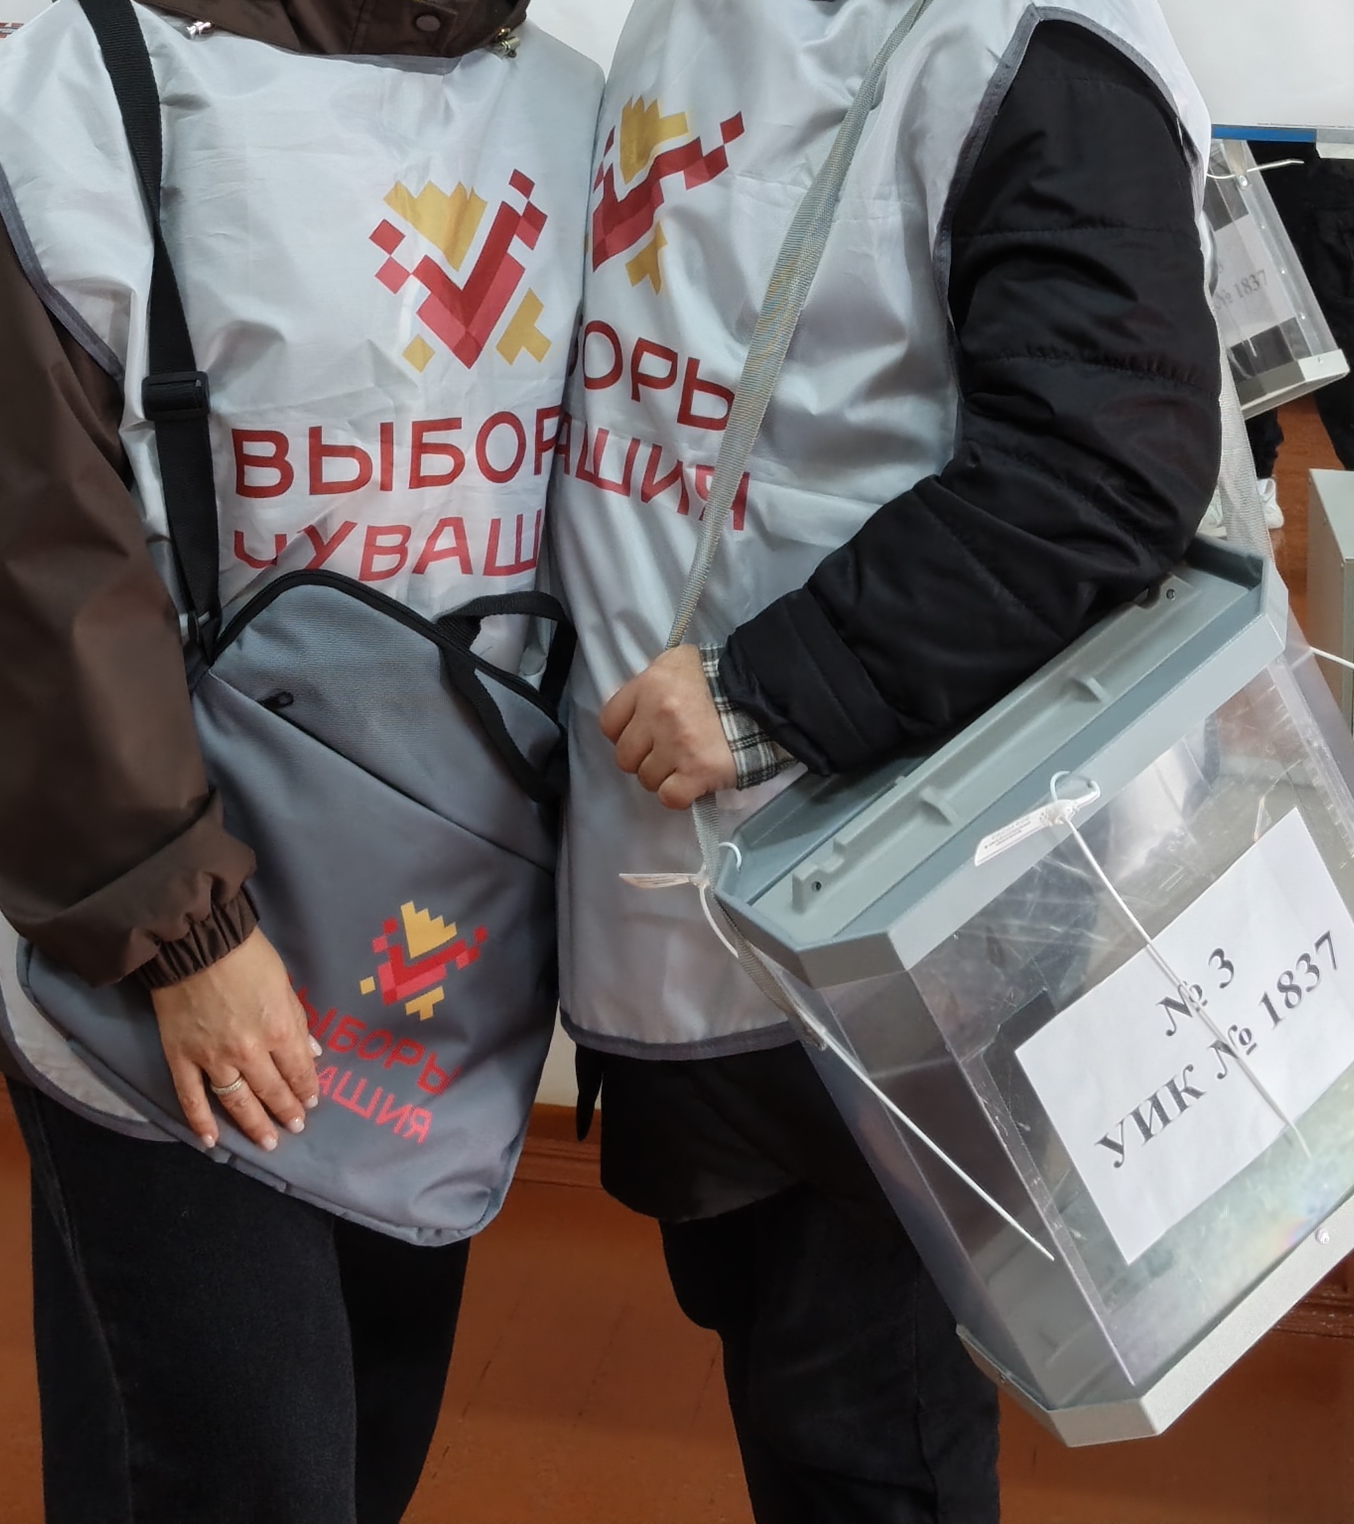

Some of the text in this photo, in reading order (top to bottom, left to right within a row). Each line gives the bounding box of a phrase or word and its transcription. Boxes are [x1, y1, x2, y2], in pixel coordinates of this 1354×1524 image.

[1234, 268, 1268, 299] 1837
[231, 405, 563, 500] ВЫБОР
[233, 509, 543, 582] ЧУВАШ
[1155, 947, 1236, 1037] № 3
[1094, 930, 1339, 1170] УИК № 1837
